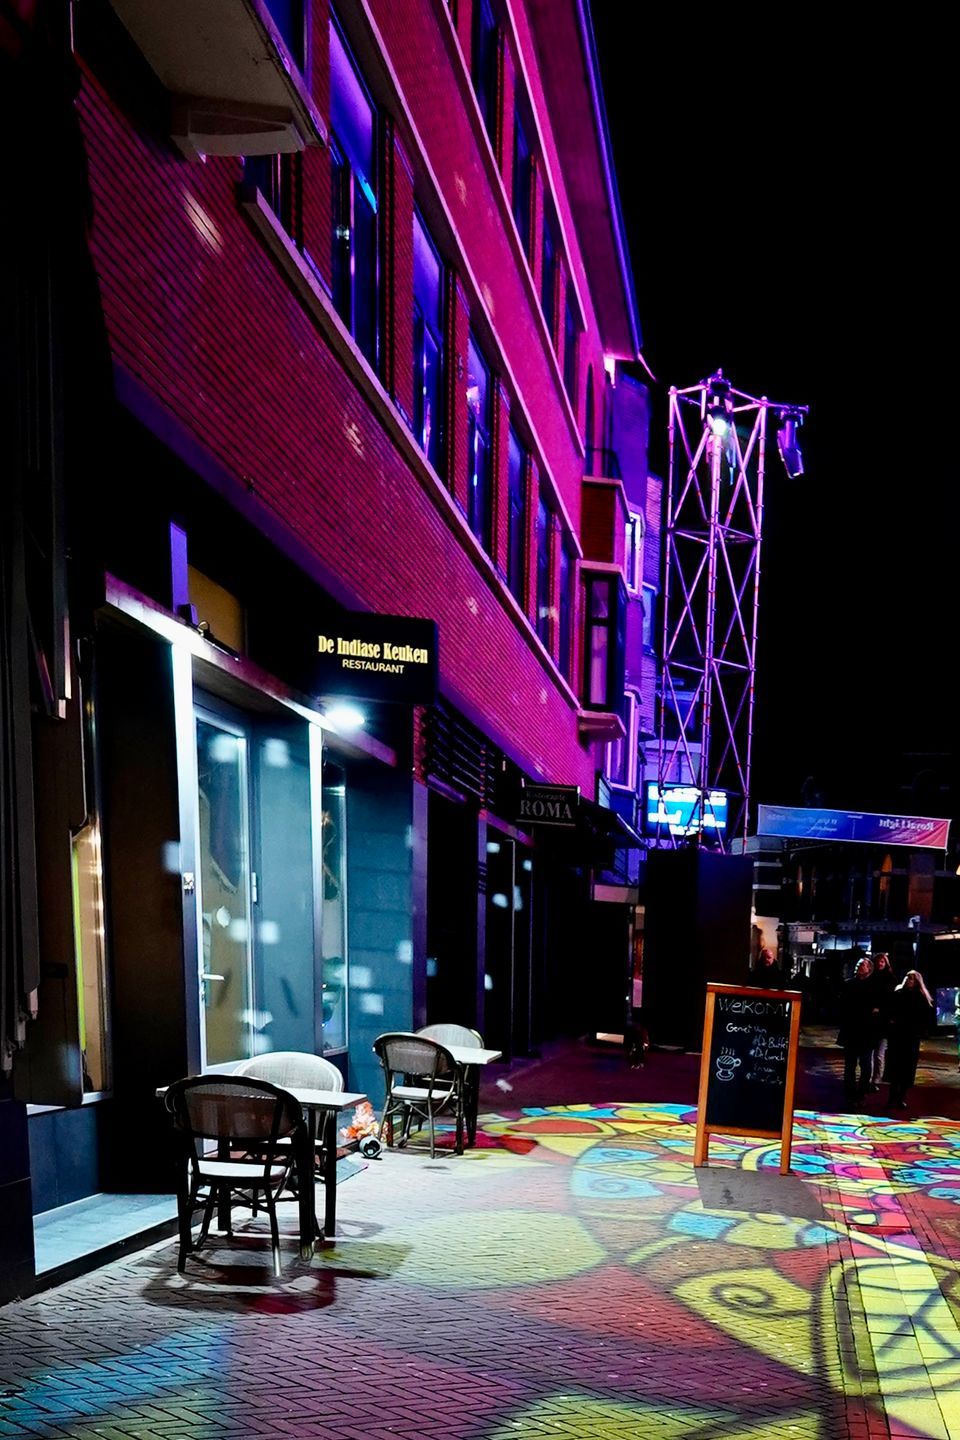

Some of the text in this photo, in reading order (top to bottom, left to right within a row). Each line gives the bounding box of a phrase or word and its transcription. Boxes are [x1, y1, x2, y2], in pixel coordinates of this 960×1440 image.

[318, 635, 428, 664] De Indiase Keuken
[342, 659, 405, 674] RESTAURANT
[520, 800, 572, 819] ROMA
